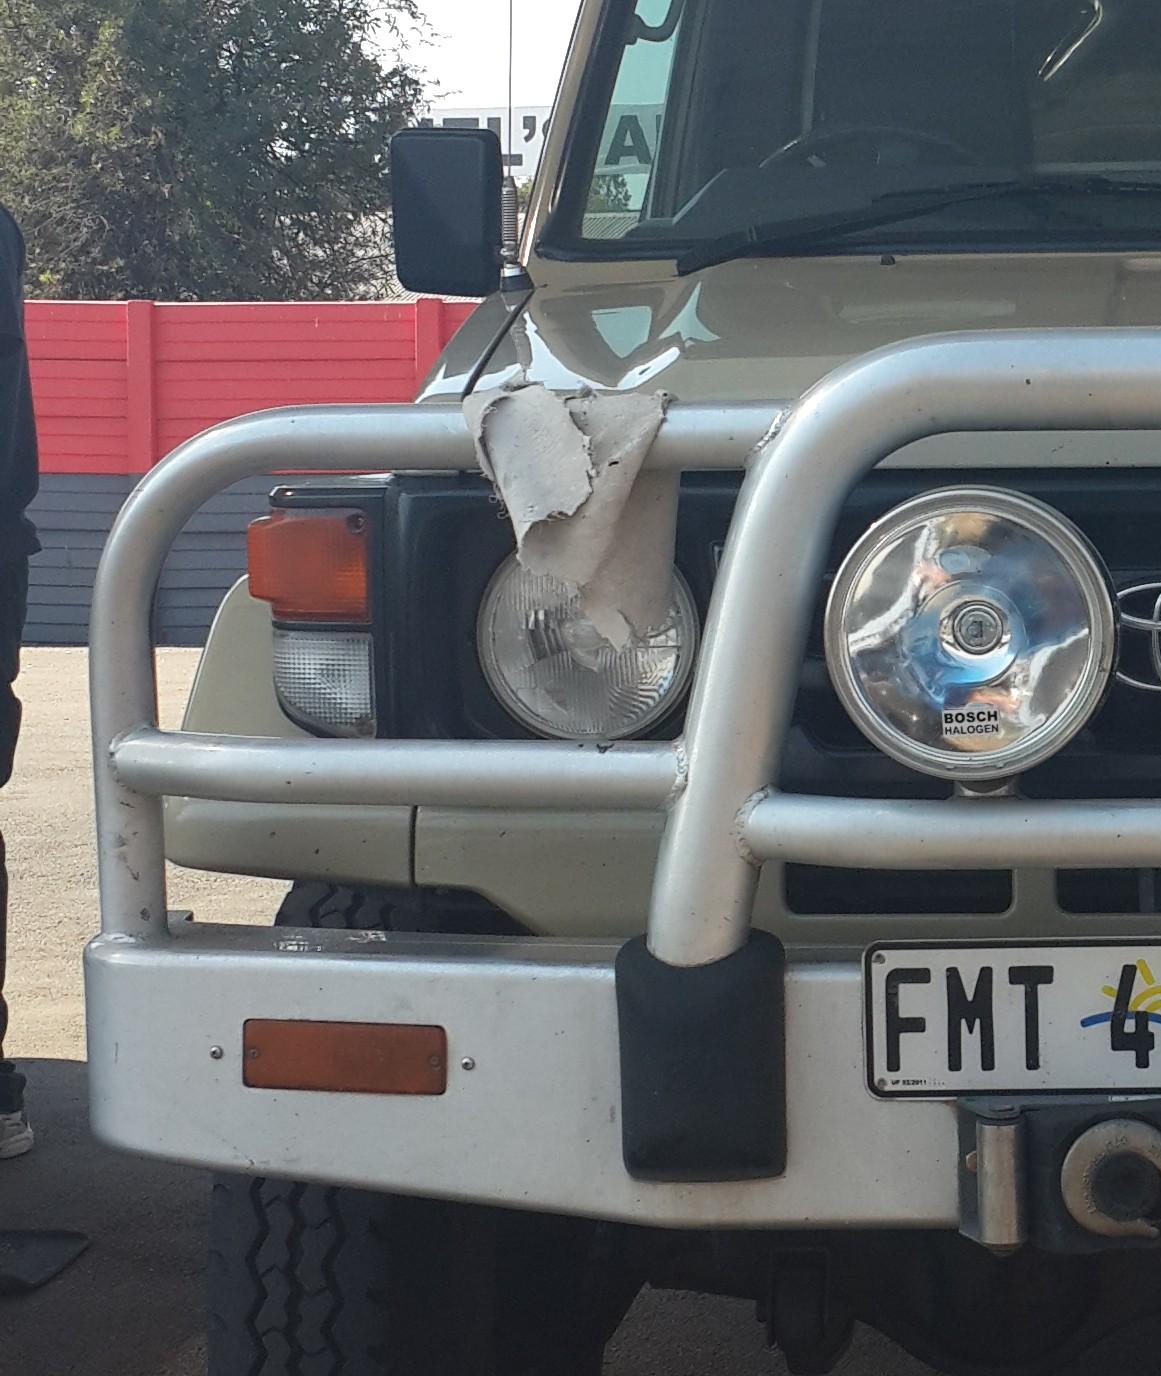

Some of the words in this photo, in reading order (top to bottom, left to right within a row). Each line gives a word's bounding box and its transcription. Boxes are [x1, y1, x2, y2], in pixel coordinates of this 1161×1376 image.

[944, 711, 998, 724] BOSCH
[944, 724, 999, 735] HALOGEN
[884, 965, 1054, 1072] FMT
